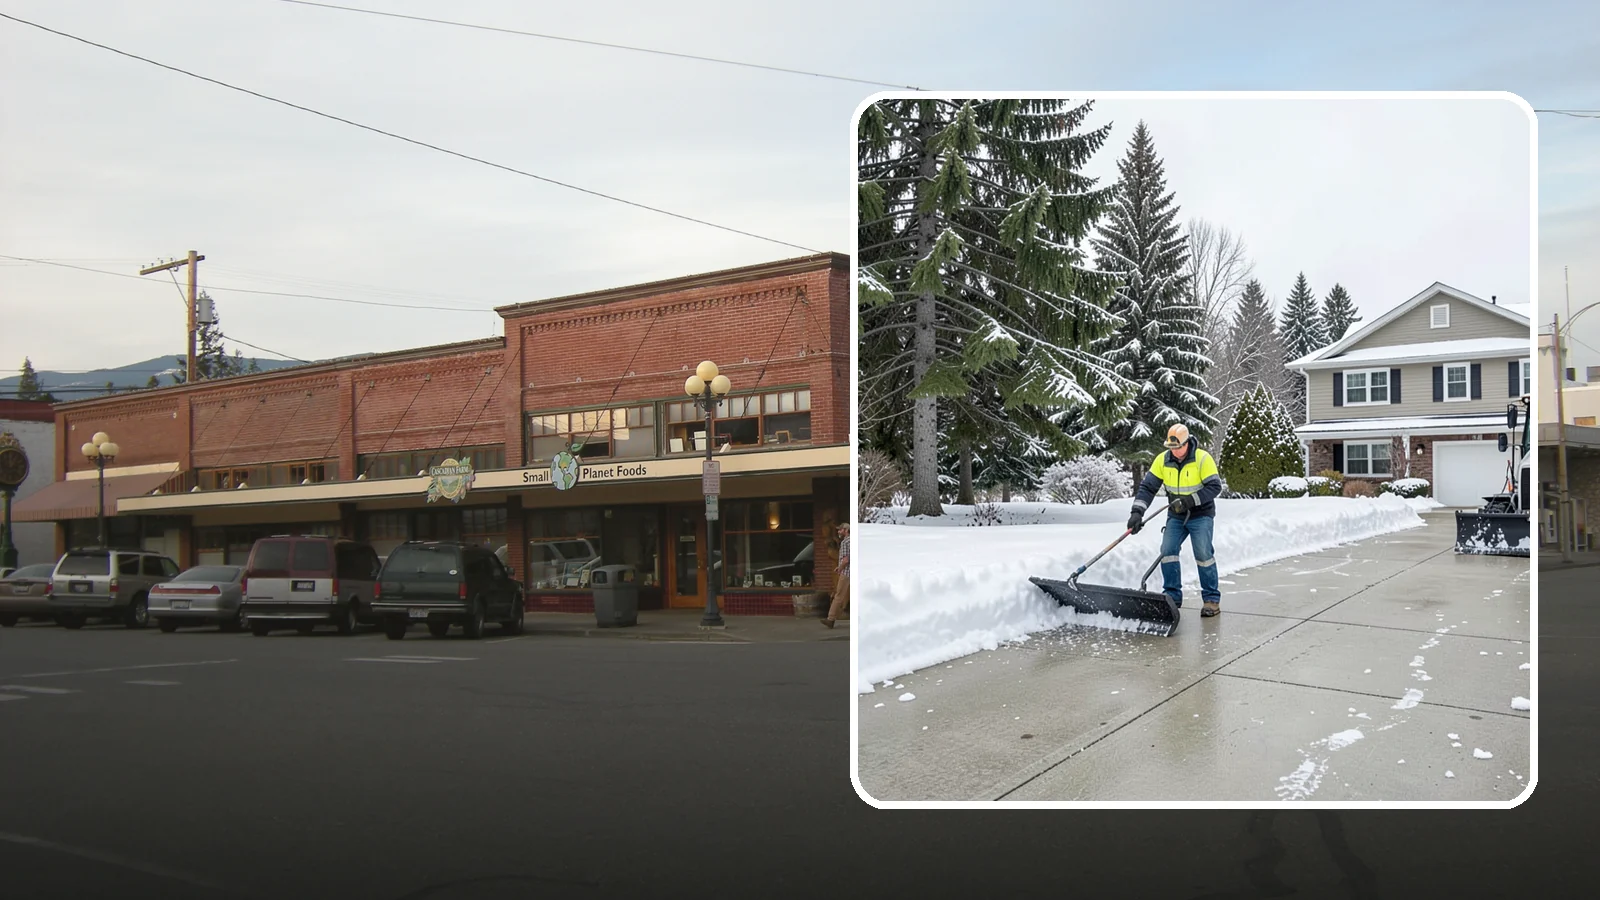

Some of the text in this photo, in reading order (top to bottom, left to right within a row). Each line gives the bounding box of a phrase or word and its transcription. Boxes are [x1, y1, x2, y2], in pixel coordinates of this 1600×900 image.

[456, 465, 469, 474] FARM
[523, 464, 647, 483] Small Planet Foods
